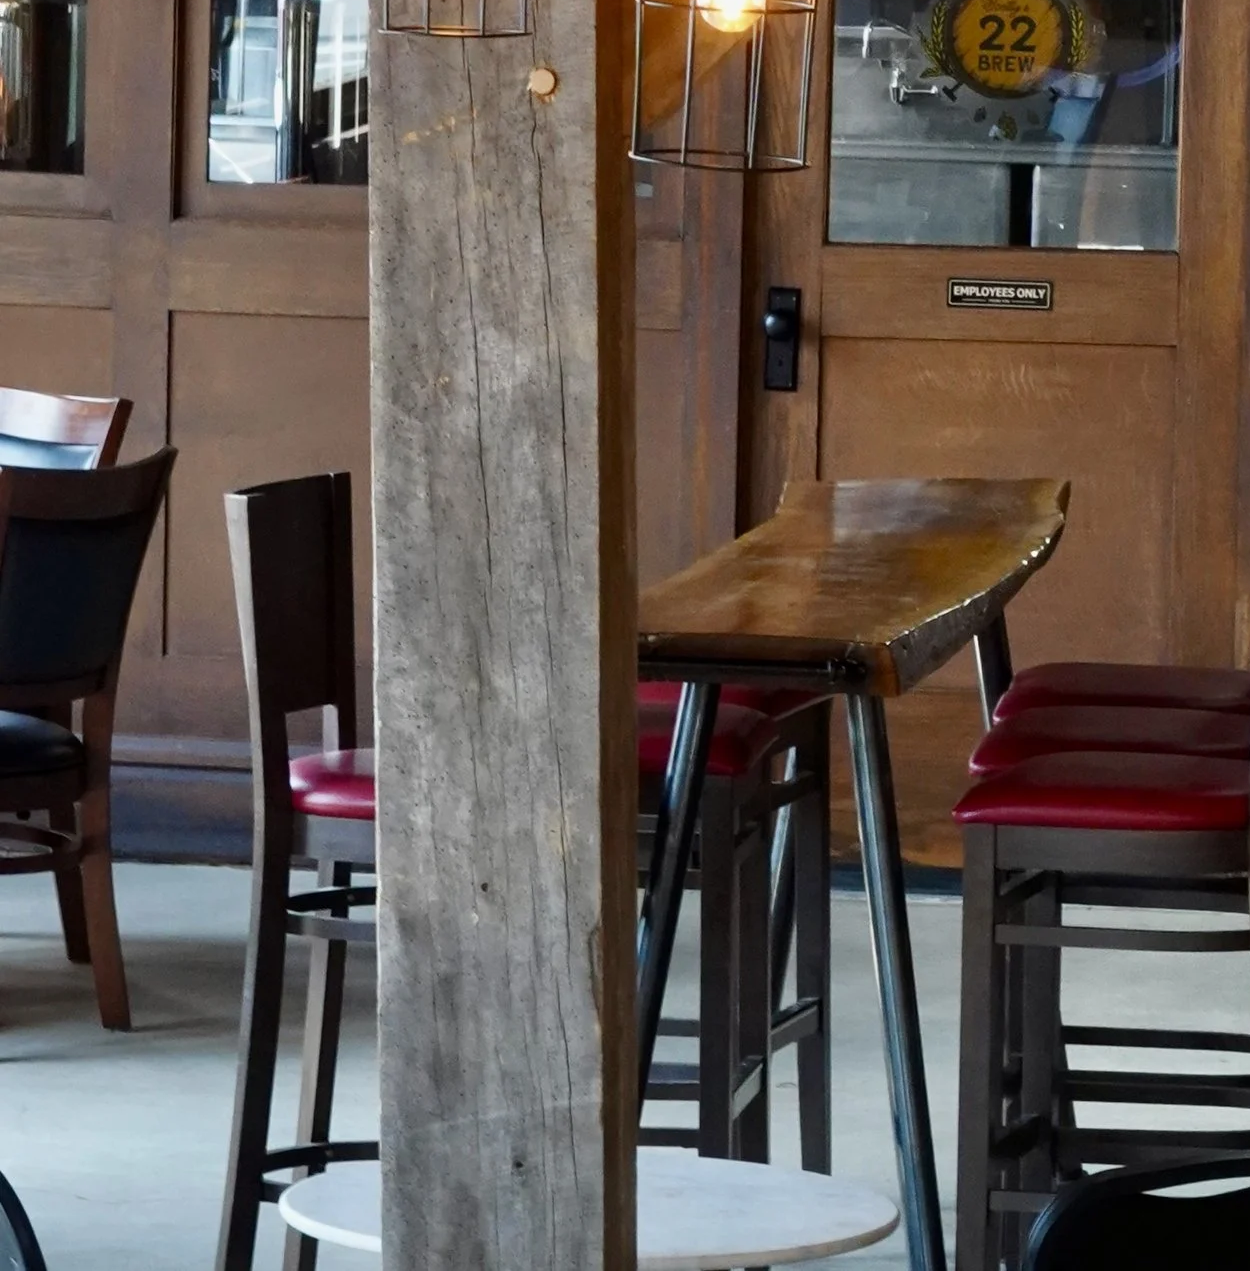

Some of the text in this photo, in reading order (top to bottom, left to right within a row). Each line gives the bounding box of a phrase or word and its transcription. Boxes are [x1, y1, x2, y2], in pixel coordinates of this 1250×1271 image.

[978, 14, 1036, 52] 22
[978, 55, 1035, 72] BREW
[953, 285, 1046, 299] EMPLOYEES ONLY
